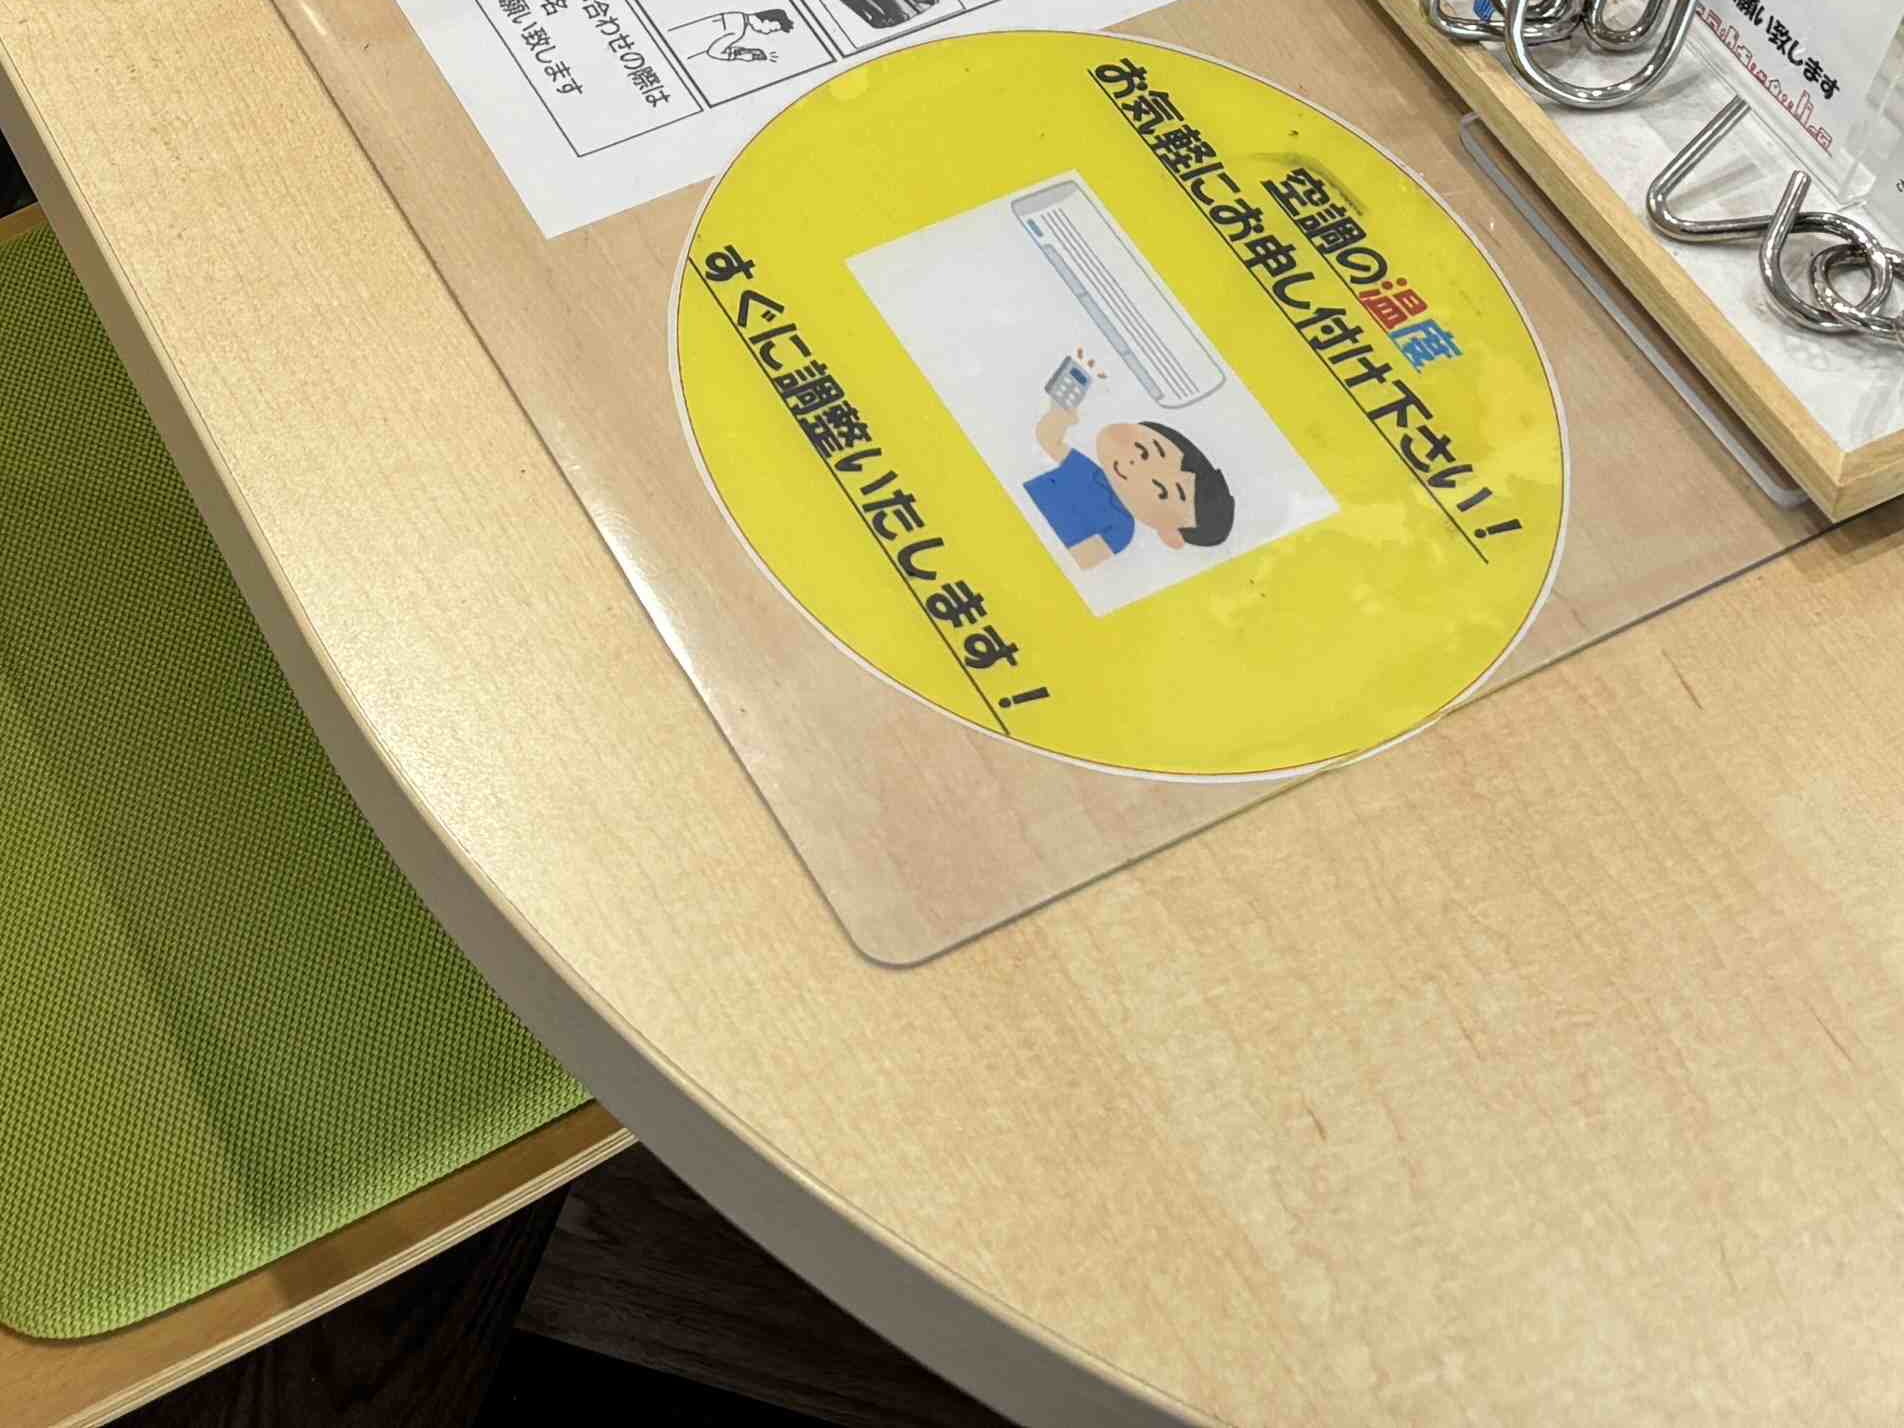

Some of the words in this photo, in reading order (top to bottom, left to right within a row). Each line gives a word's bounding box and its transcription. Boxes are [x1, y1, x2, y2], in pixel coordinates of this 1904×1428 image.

[703, 244, 1048, 709] すぐに調整いたします！
[1091, 56, 1524, 542] お気軽にお申し付け下さい！
[1261, 169, 1462, 372] 空調の温度
